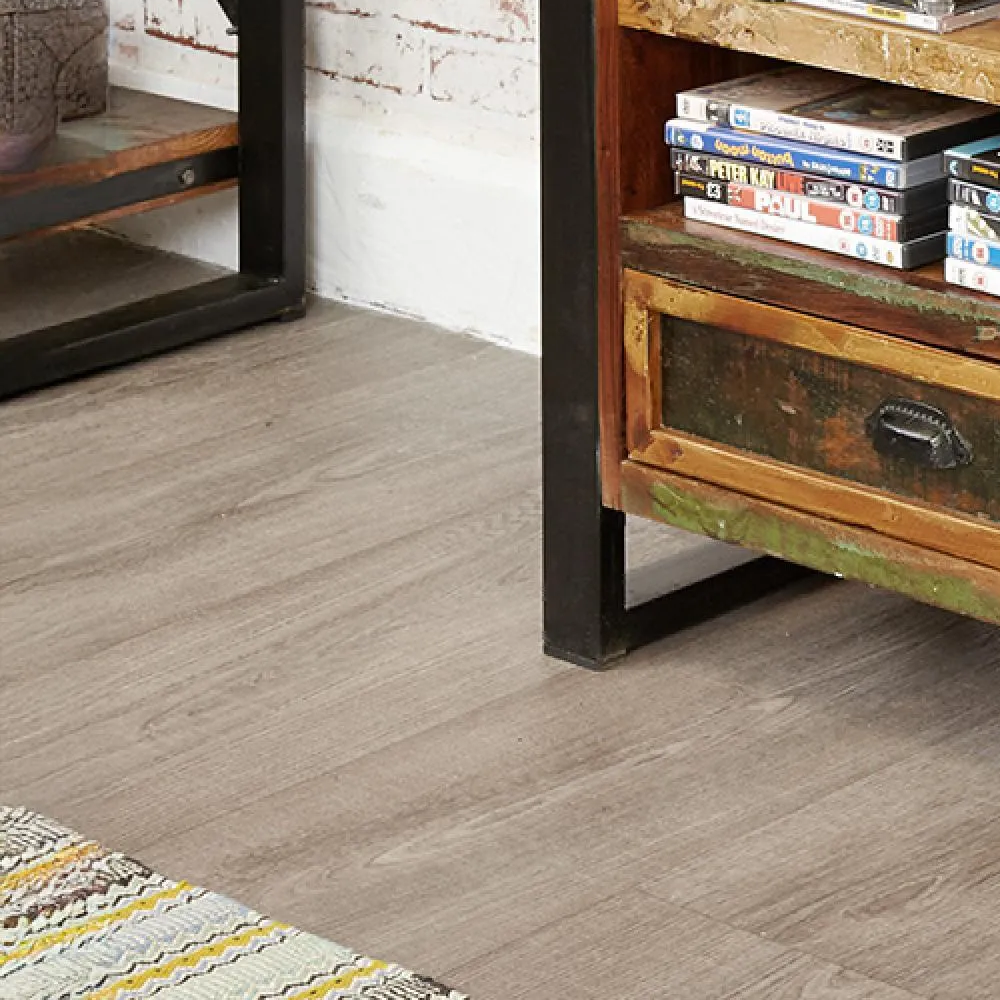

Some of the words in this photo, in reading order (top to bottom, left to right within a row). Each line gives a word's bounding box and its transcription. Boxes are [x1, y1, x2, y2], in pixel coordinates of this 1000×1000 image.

[709, 158, 747, 183] PETER
[750, 167, 775, 190] KAY
[755, 190, 817, 223] PAUL
